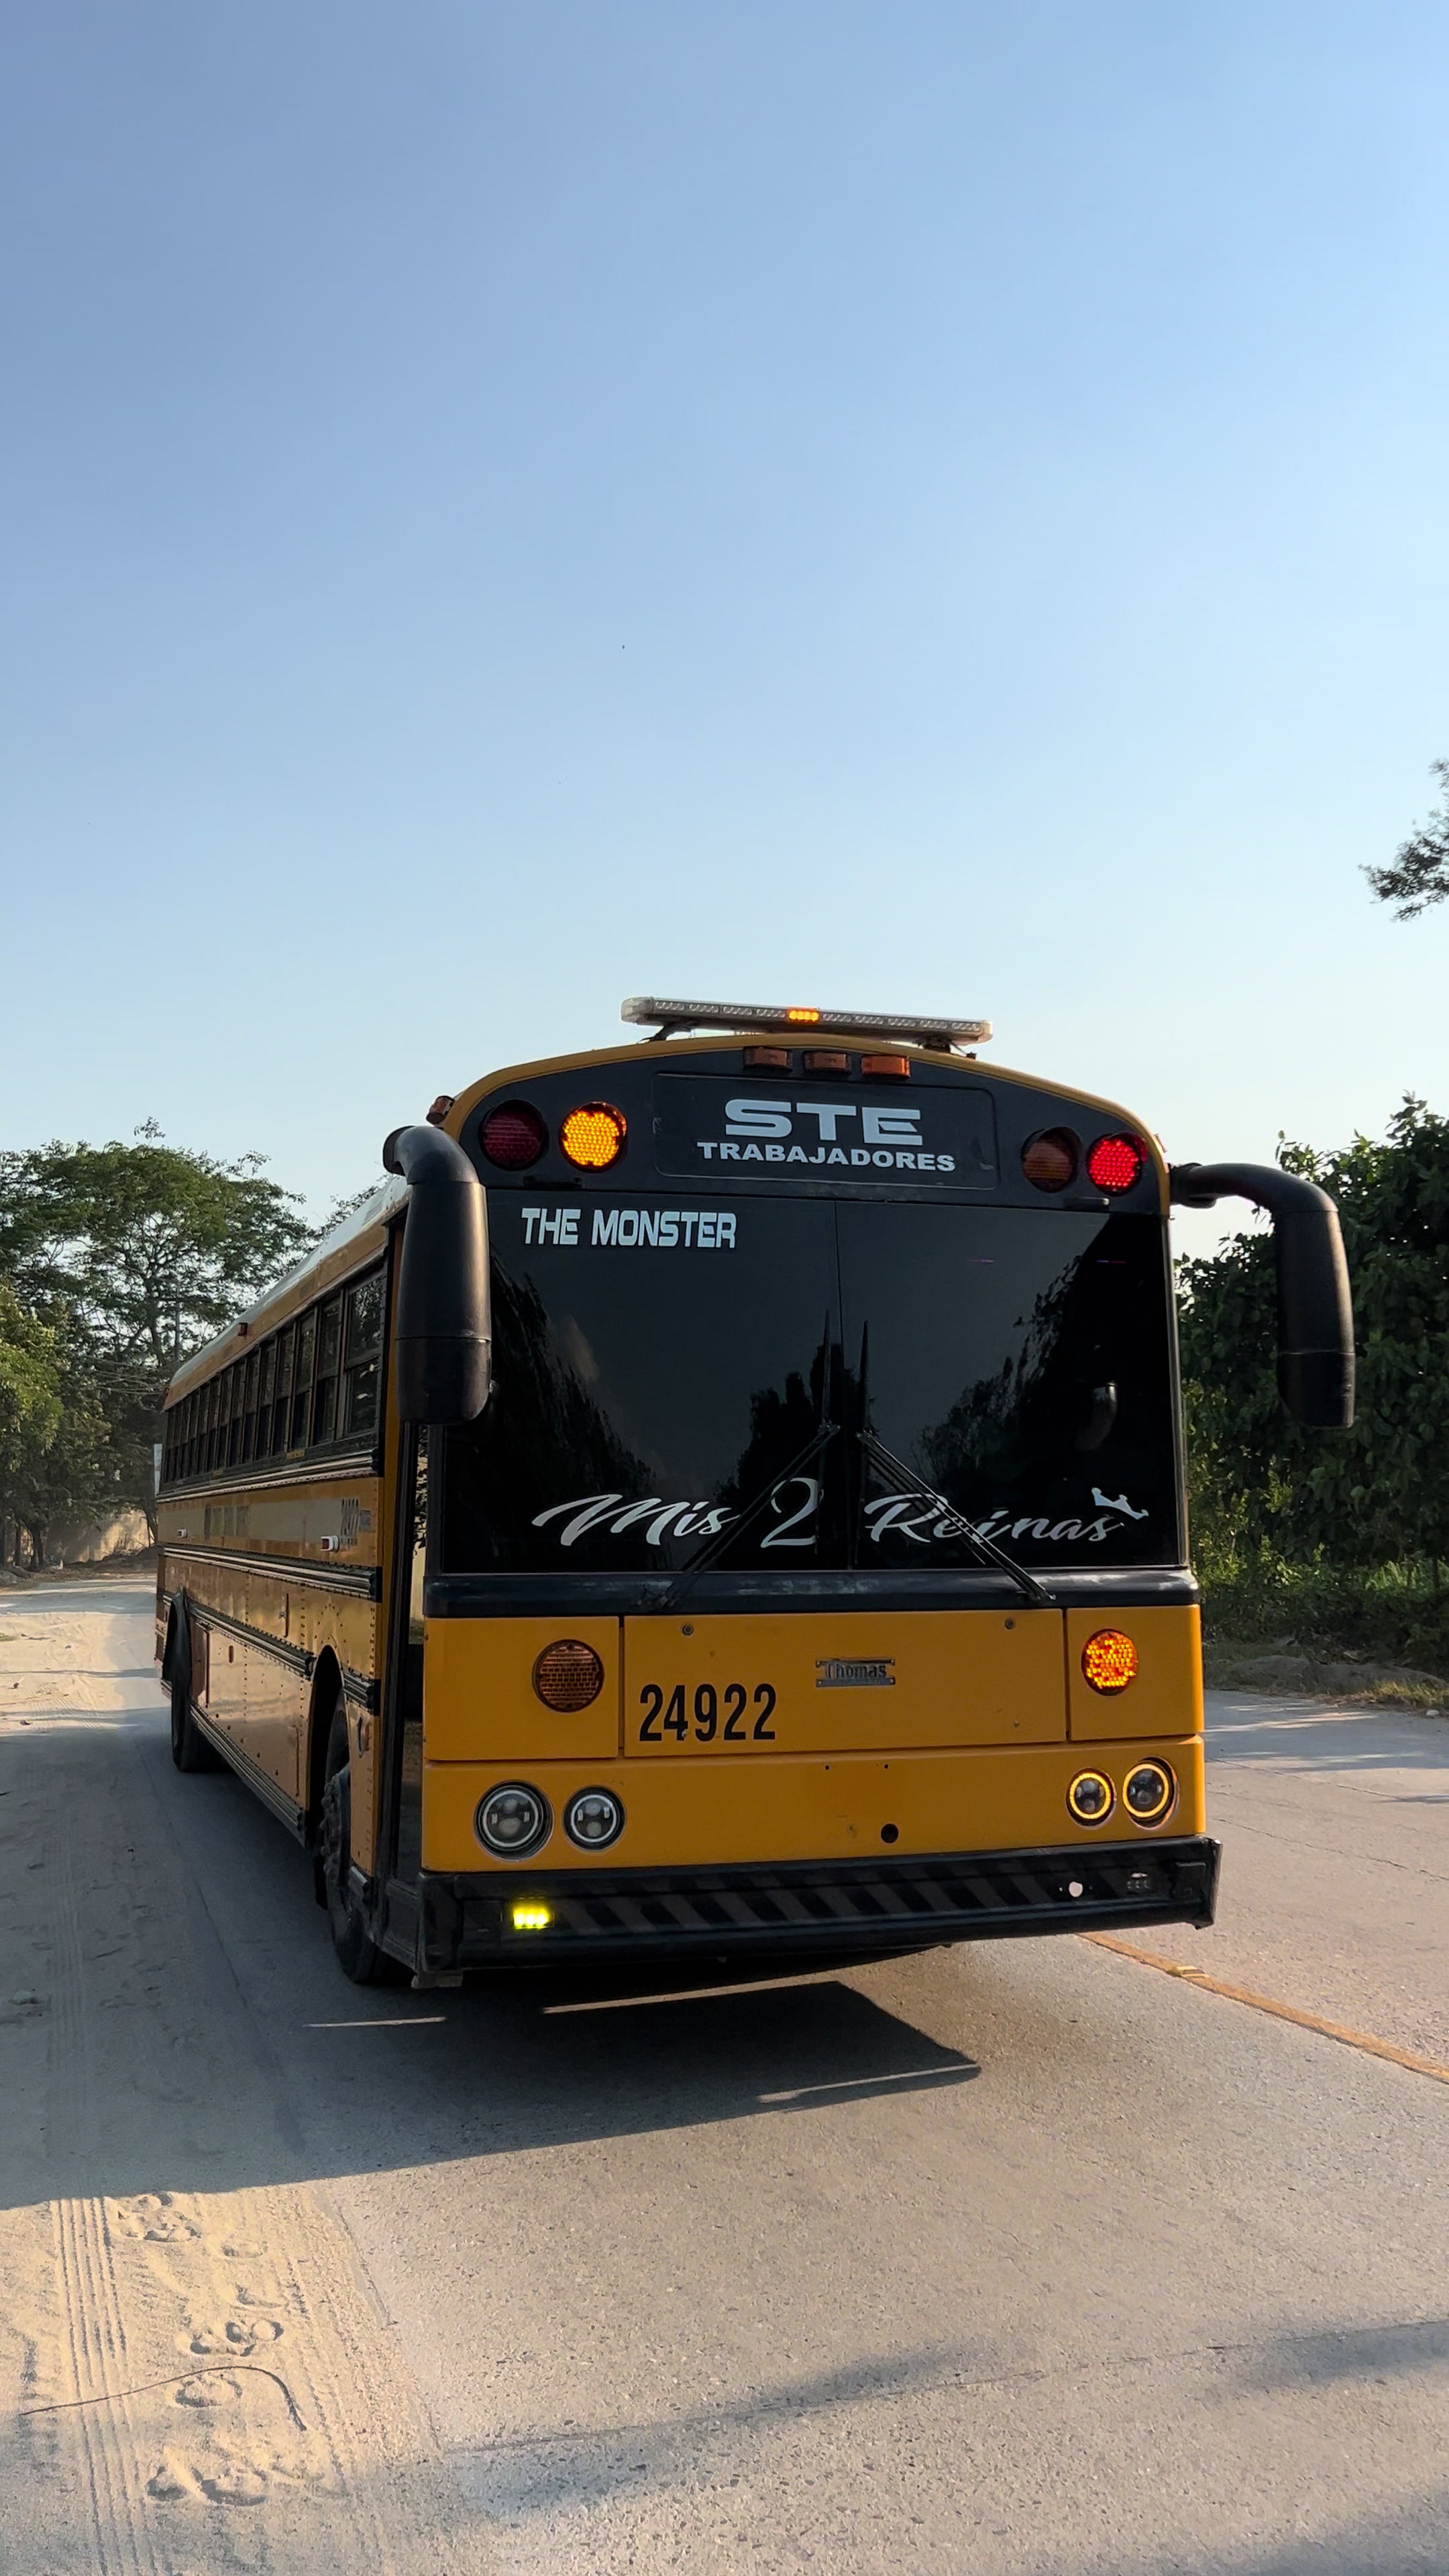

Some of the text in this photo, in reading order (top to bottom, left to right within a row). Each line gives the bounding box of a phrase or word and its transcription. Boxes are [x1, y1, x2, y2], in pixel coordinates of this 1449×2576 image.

[725, 1099, 923, 1146] STE
[697, 1142, 955, 1171] TRABAJADORES
[521, 1208, 737, 1248] THE MONSTER
[532, 1477, 1125, 1548] Mis 2 Reinas
[824, 1662, 887, 1678] Thomas
[639, 1683, 776, 1742] 24922
